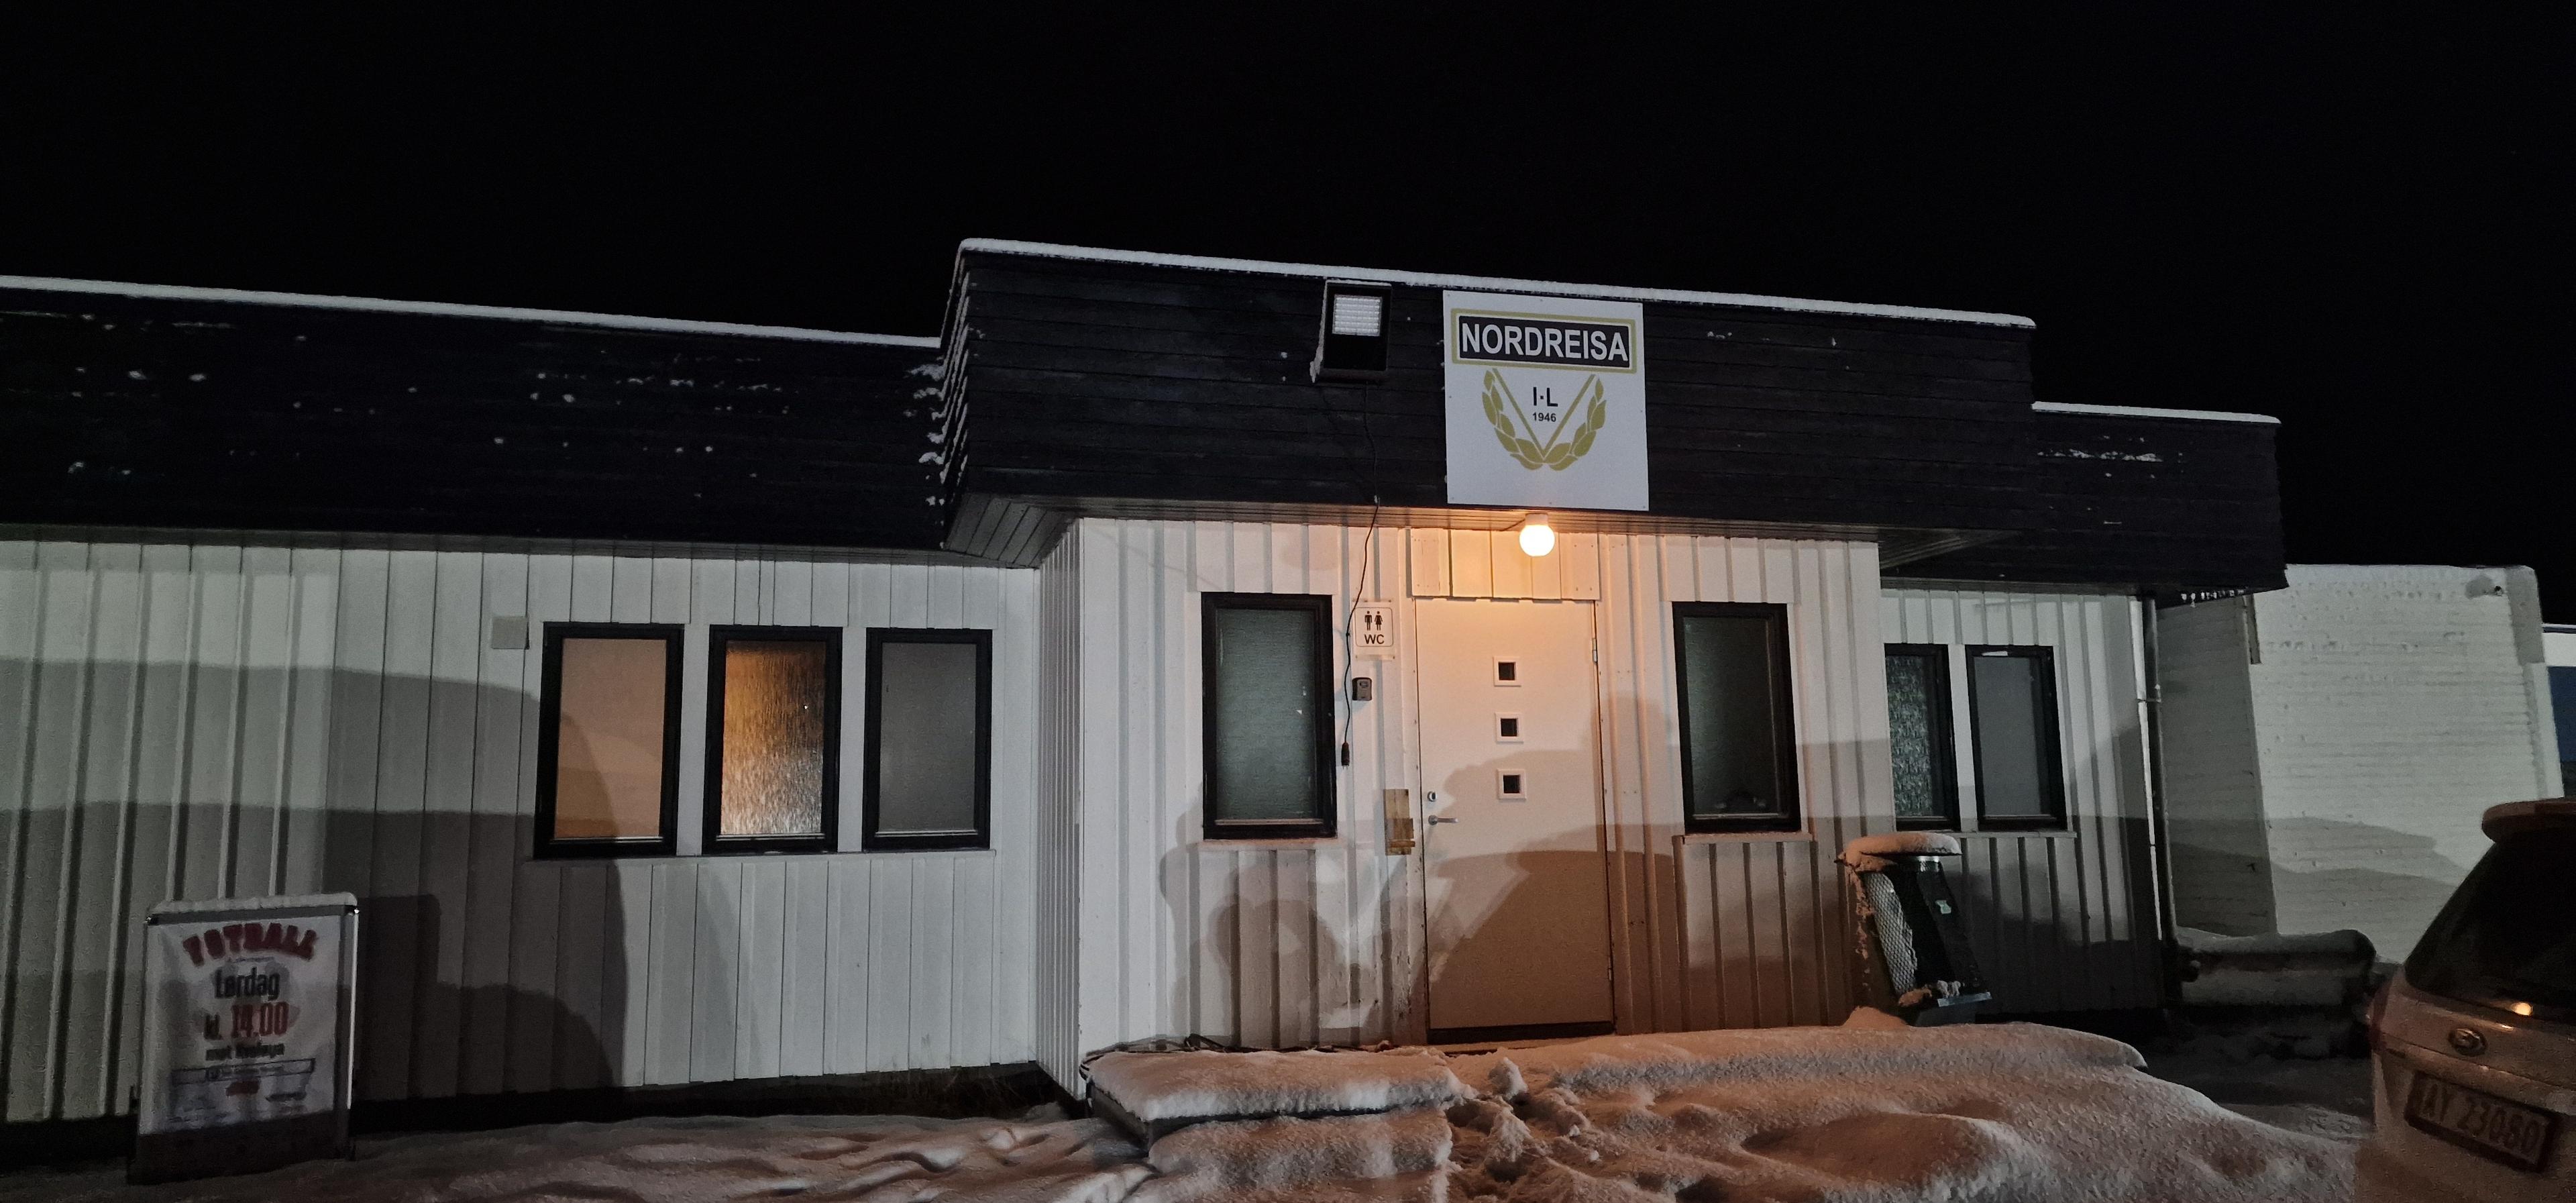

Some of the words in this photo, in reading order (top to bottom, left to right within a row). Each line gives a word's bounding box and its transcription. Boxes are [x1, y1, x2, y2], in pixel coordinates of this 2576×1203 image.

[1461, 322, 1629, 362] NORDREISA
[1532, 411, 1557, 423] 1946
[1364, 634, 1385, 645] WC
[214, 967, 280, 1001] Lørdag
[231, 1001, 290, 1039] 14.00
